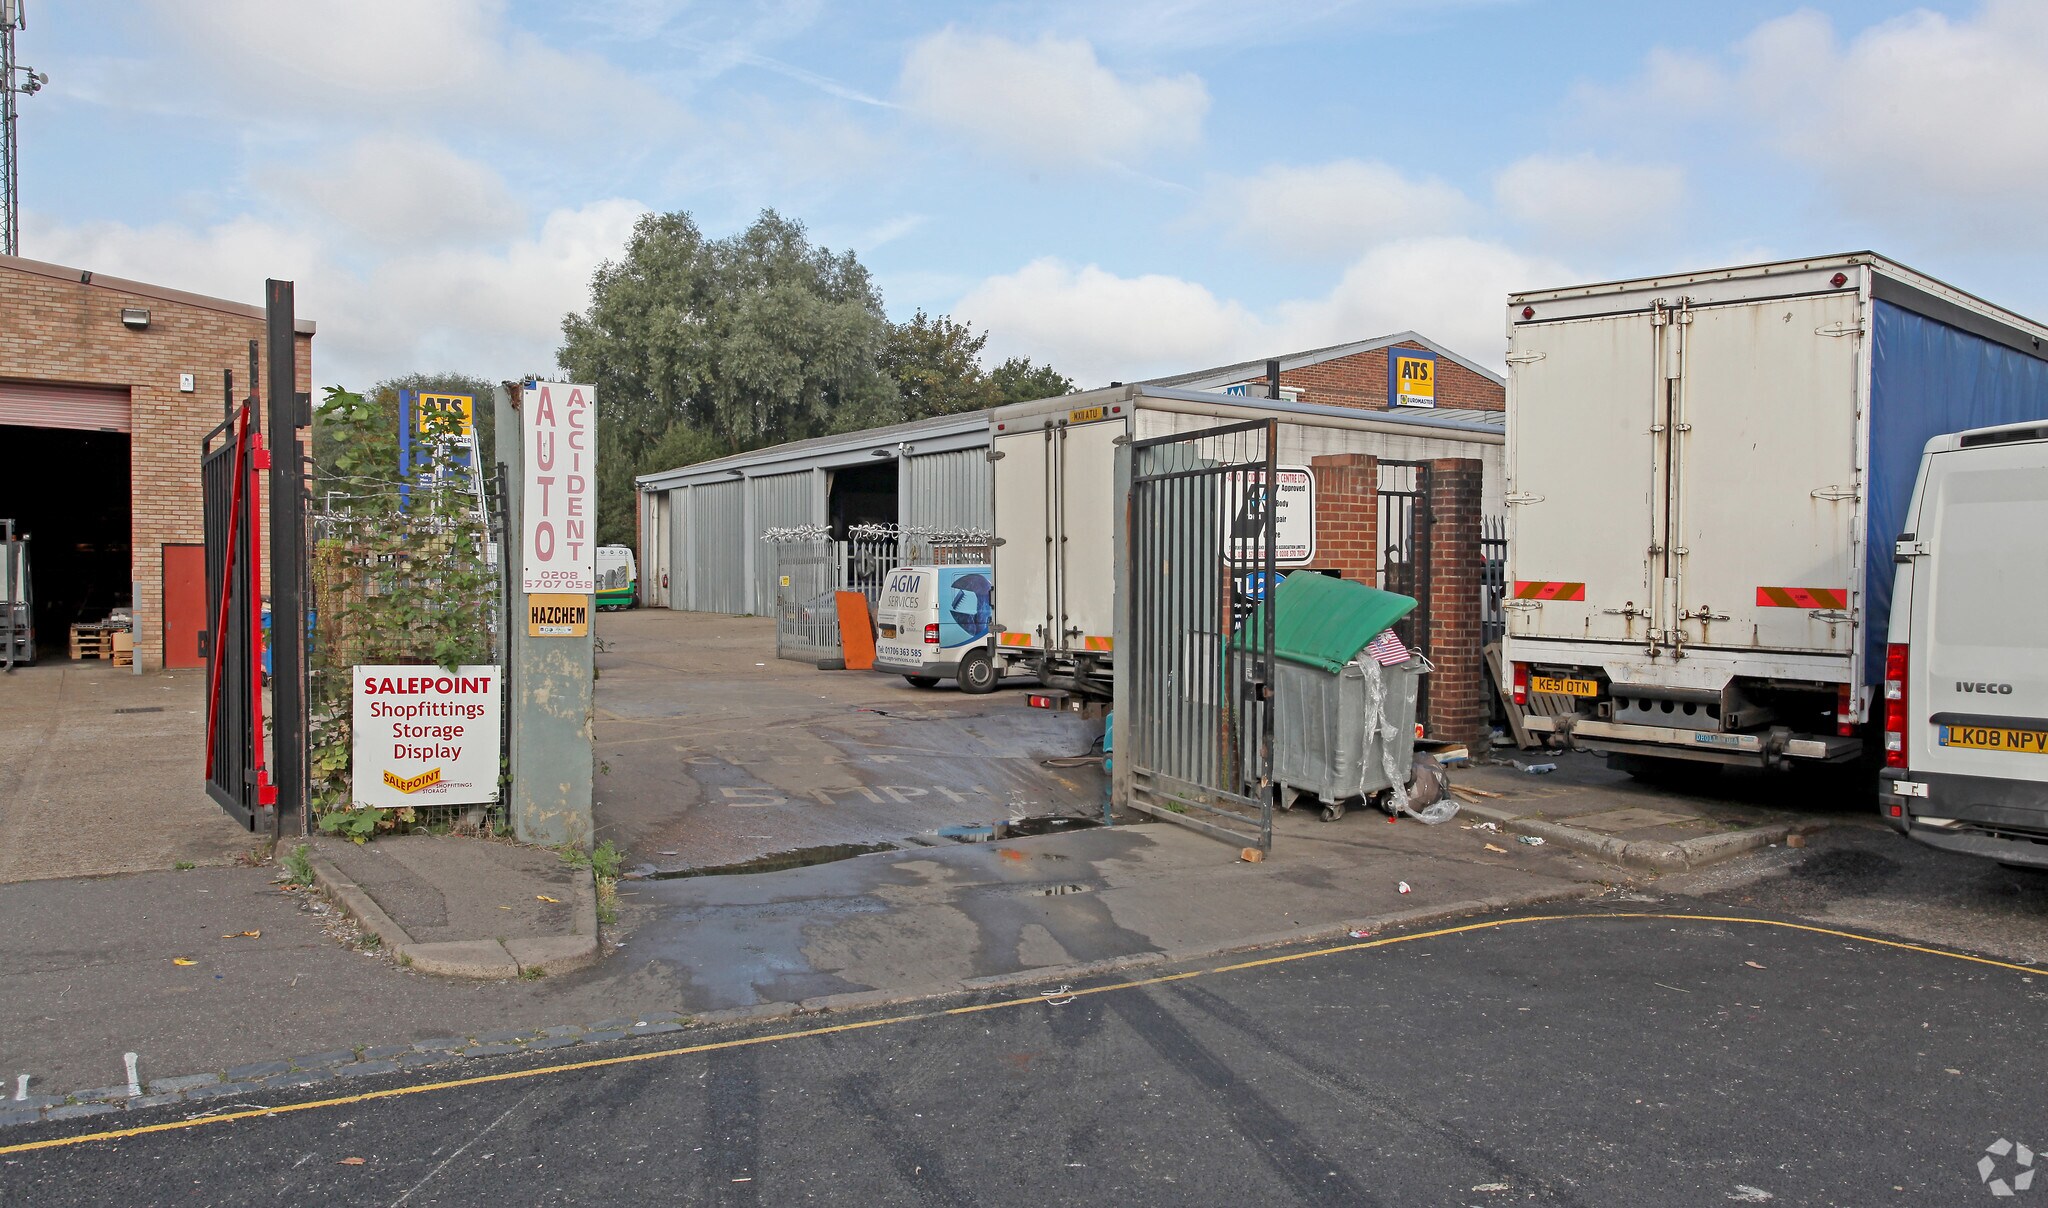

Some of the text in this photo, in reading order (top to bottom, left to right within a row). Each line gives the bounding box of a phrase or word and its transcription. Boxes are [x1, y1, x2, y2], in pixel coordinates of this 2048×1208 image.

[1401, 361, 1428, 380] ATS
[1085, 409, 1098, 419] ATU
[534, 386, 556, 562] AUTO
[566, 388, 586, 561] ACCIDENT
[1281, 474, 1297, 483] CENTRE
[540, 571, 578, 579] 0208
[889, 575, 921, 593] AGM
[524, 580, 593, 589] 5707 058
[887, 595, 919, 609] SERVICES
[531, 606, 586, 624] HAZCHEM
[900, 647, 910, 657] 363
[364, 677, 491, 695] SALEPOINT
[1538, 679, 1590, 694] KE51 OTN
[1956, 682, 2013, 695] IVECO
[370, 701, 485, 720] Shopfittings
[392, 722, 464, 741] Storage
[1950, 727, 2048, 750] LK08 NPV
[394, 743, 462, 762] Display
[383, 769, 441, 791] SALEPOINT
[718, 785, 1003, 807] 5 MPH
